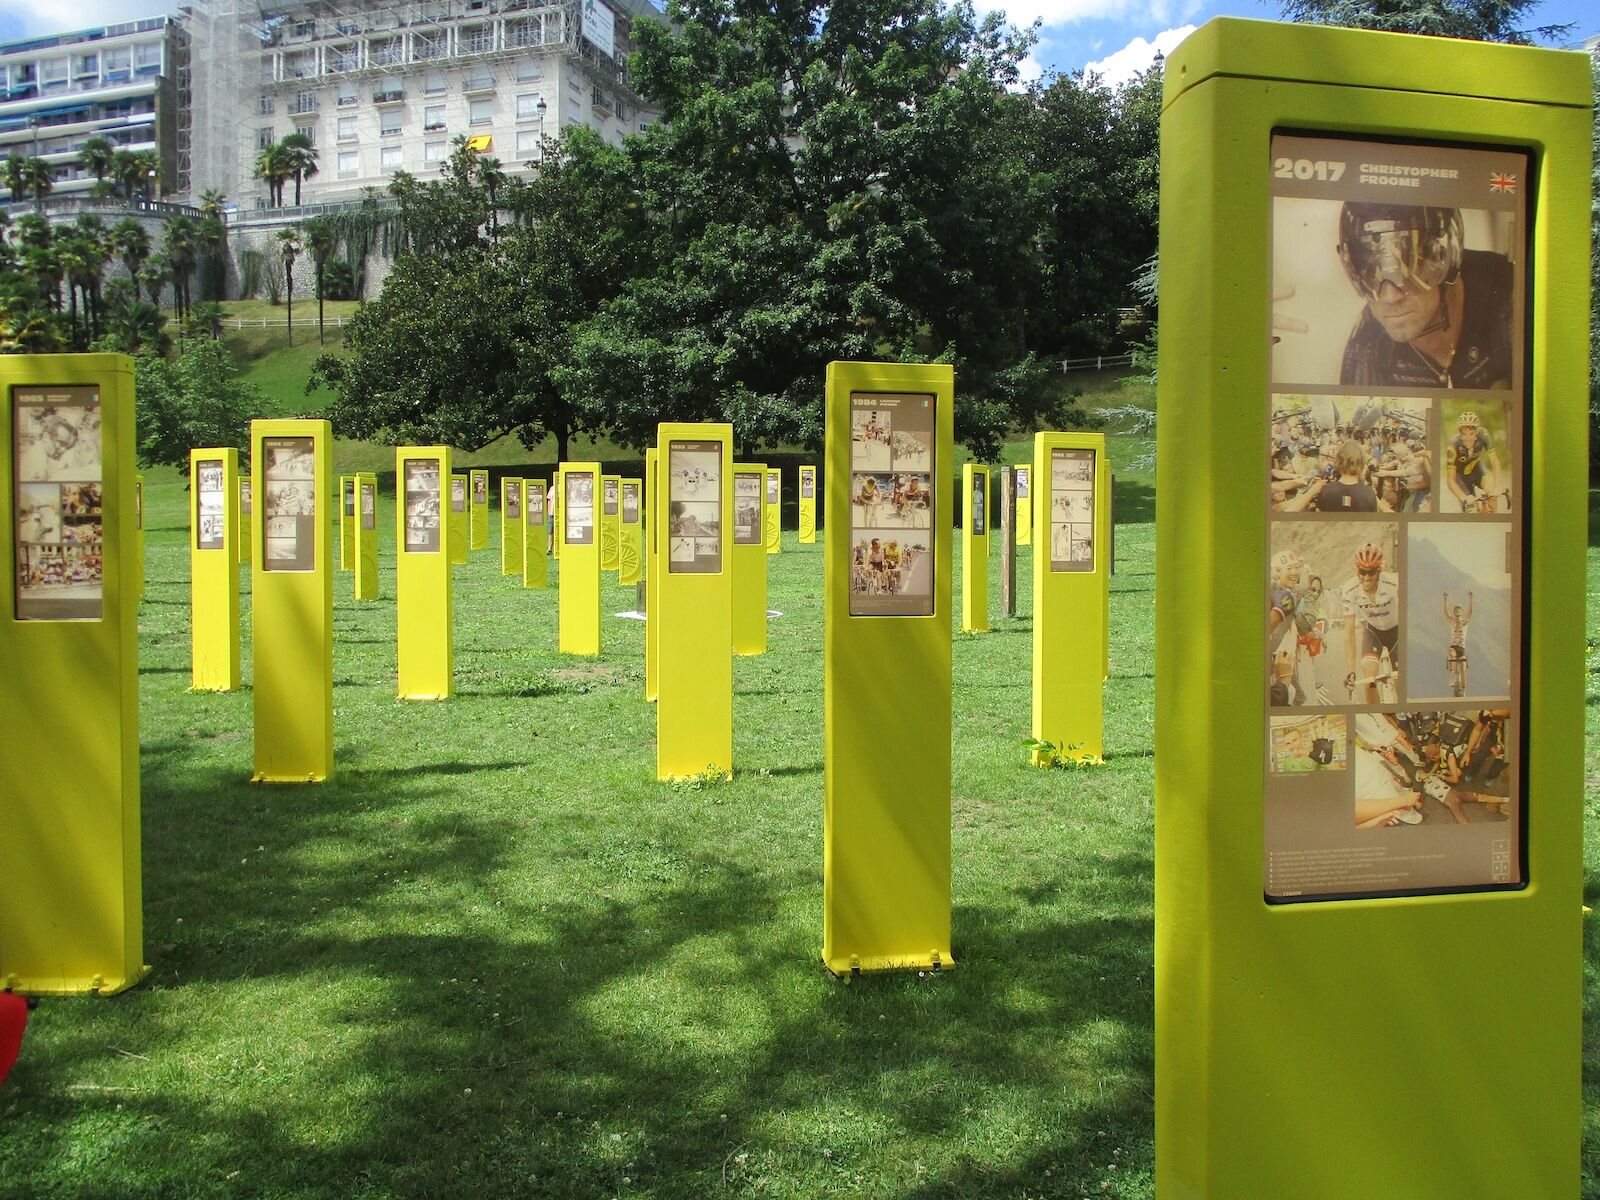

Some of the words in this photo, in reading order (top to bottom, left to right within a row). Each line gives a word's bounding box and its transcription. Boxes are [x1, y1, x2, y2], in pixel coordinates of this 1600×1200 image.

[1274, 157, 1346, 182] 2017
[1359, 163, 1459, 179] CHRISTOPHER
[1359, 175, 1421, 188] FROOME
